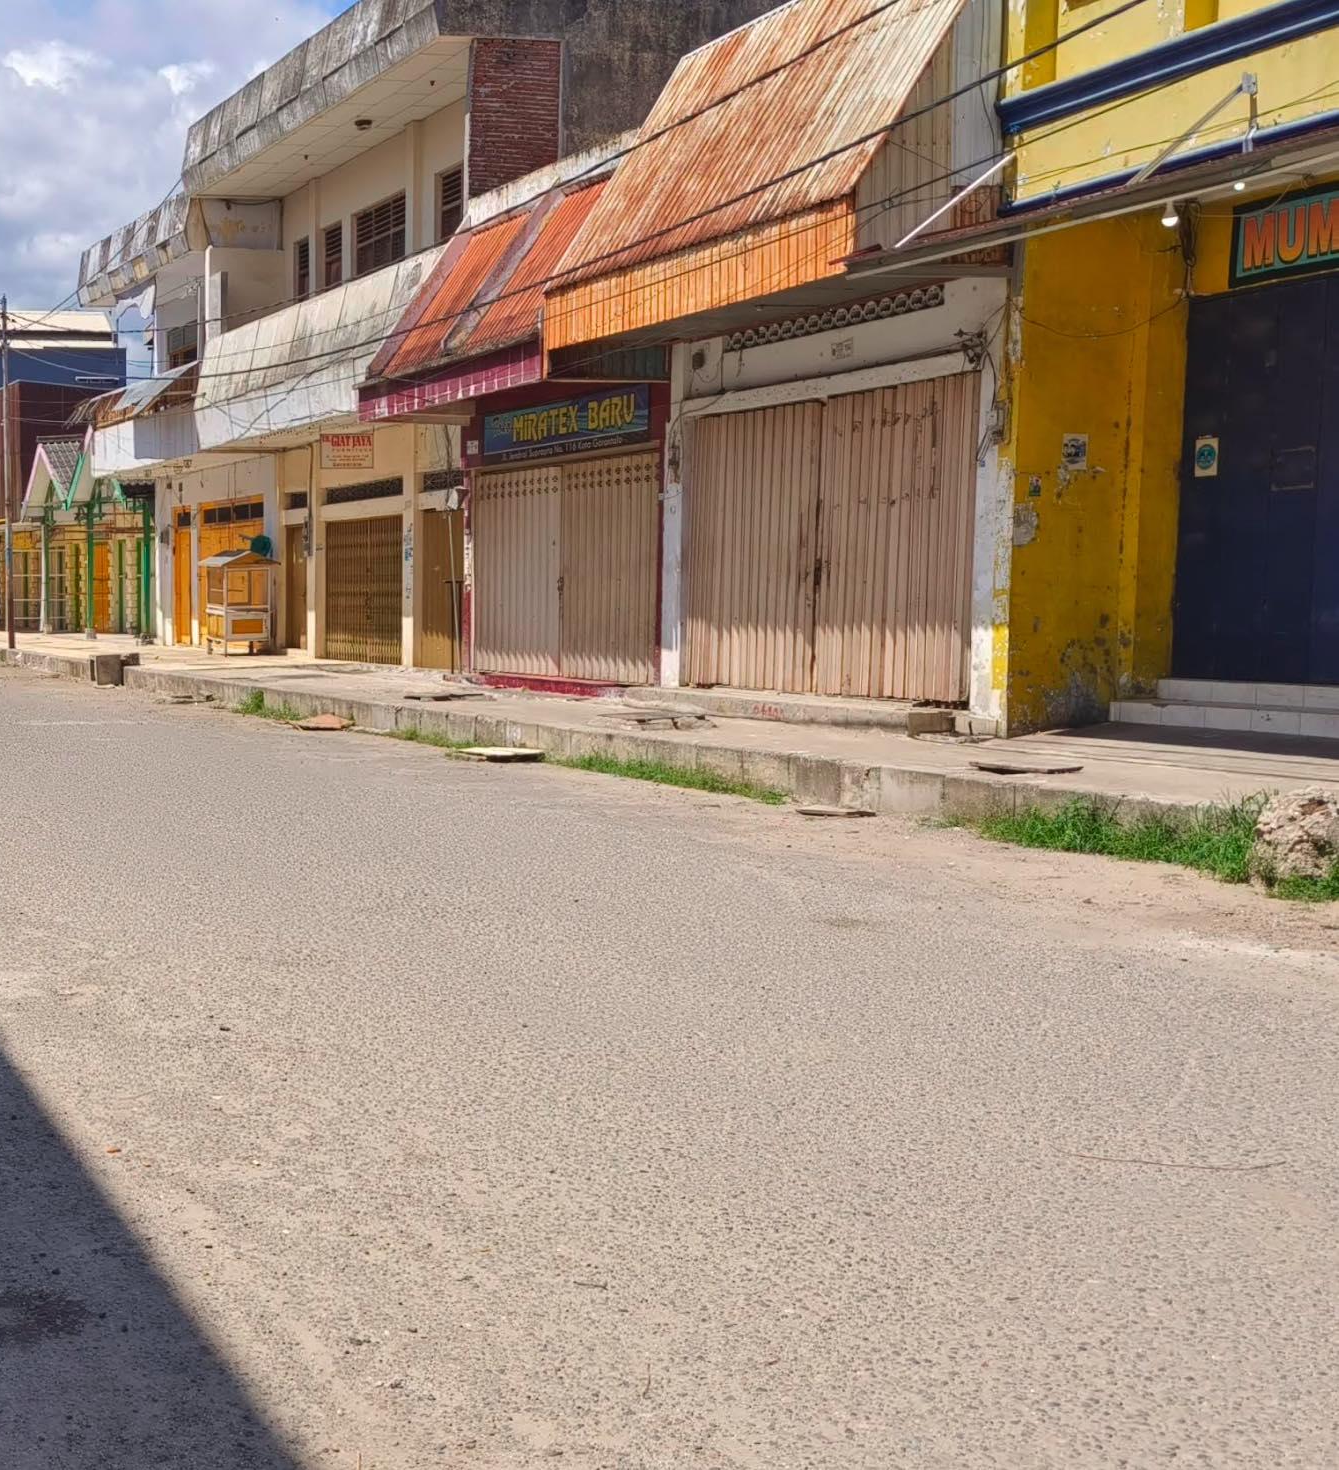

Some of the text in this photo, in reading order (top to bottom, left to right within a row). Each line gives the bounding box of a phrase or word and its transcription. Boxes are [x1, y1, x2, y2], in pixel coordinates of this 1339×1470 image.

[588, 393, 634, 430] BARU
[351, 435, 372, 448] JAYA
[565, 442, 577, 452] 116
